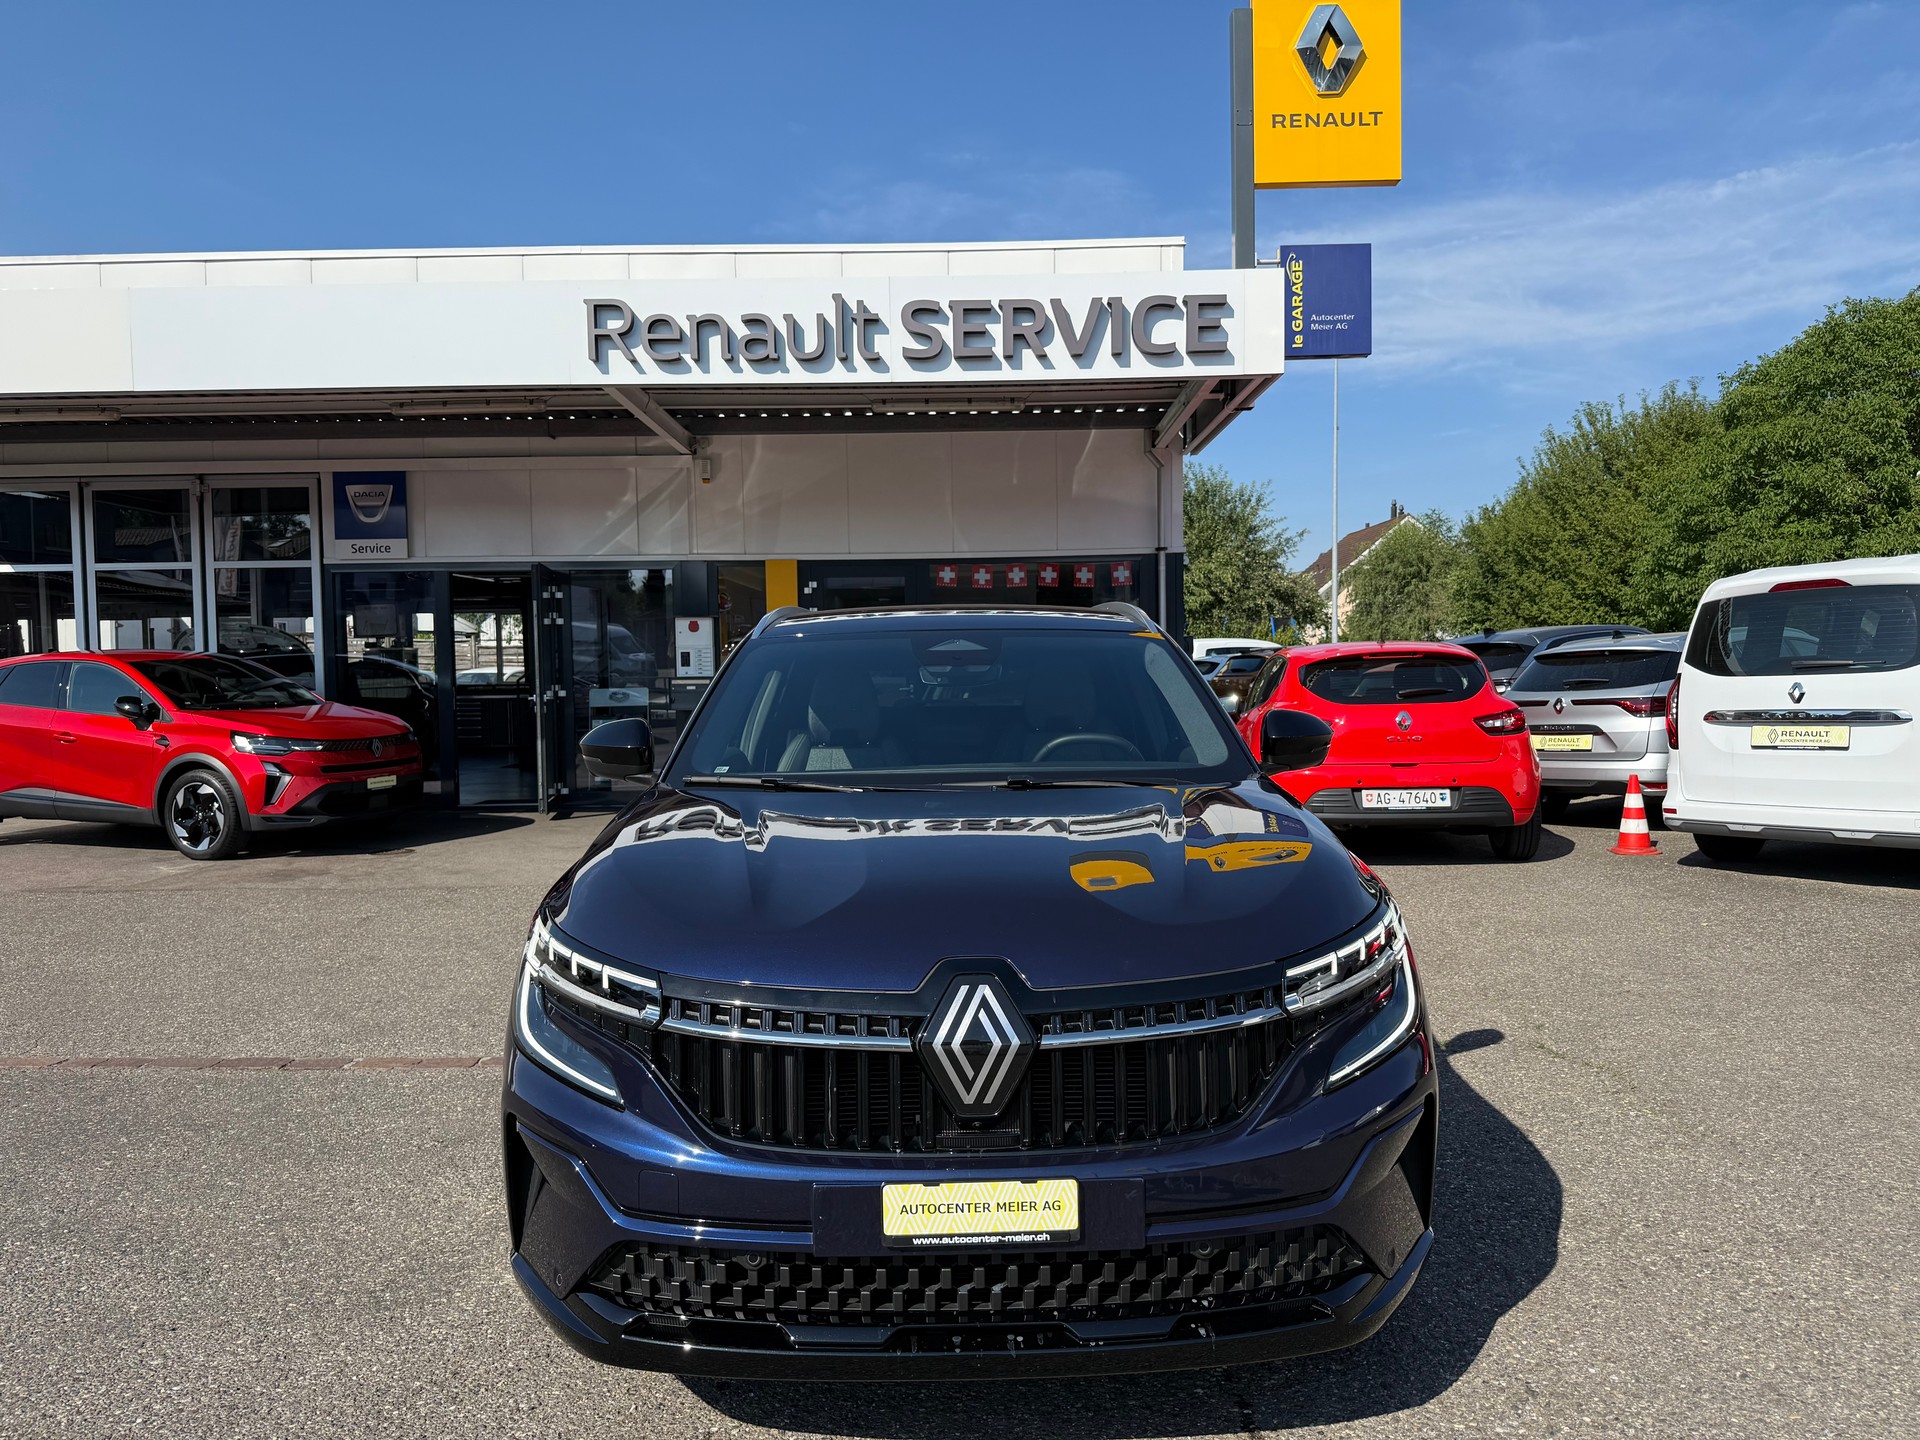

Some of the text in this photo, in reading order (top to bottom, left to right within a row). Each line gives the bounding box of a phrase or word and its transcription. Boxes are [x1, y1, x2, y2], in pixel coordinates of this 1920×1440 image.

[1271, 111, 1384, 129] RENAULT
[1291, 258, 1304, 349] le GARAGE
[1310, 313, 1355, 322] Autocenter
[583, 293, 1228, 365] Renault SERVICE
[1310, 322, 1348, 331] Meier AG
[351, 543, 391, 554] Service
[1386, 735, 1423, 743] CLIO
[1781, 730, 1831, 738] RENAULT
[900, 1200, 1062, 1215] AUTOCENTER MEIER AG
[913, 1233, 1050, 1245] www.autocenter-meier.ch
